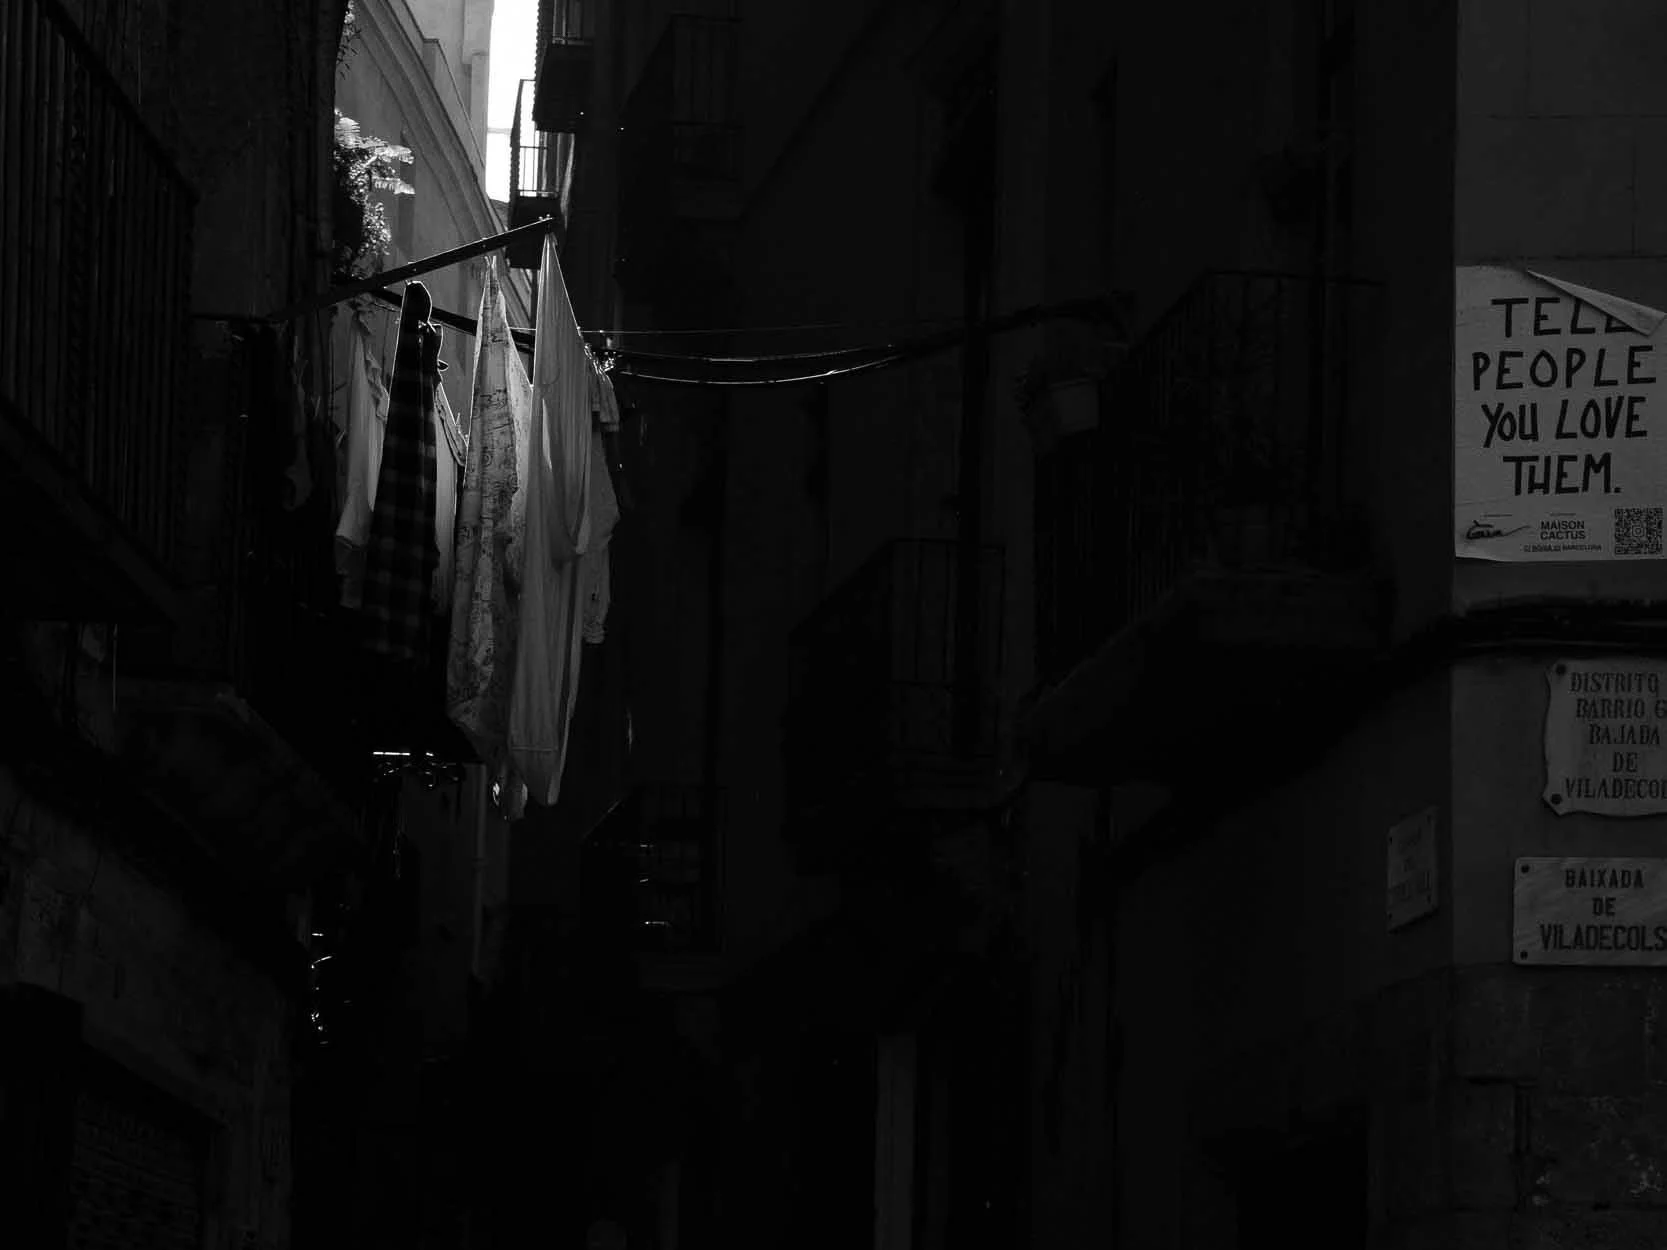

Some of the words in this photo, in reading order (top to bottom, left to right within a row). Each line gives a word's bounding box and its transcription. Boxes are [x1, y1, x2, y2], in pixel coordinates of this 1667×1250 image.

[1491, 297, 1635, 338] TELL
[1472, 345, 1657, 391] PEOPLE
[1555, 396, 1648, 439] LOVE
[1503, 452, 1622, 496] THEM.
[1540, 520, 1585, 531] MAISON
[1540, 531, 1586, 541] CACTUS
[1570, 672, 1660, 695] DISTRITO
[1576, 698, 1646, 719] BARRIO
[1589, 723, 1661, 745] BAJADA
[1612, 751, 1638, 772] DE
[1565, 868, 1644, 889] BAIXADA
[1592, 897, 1617, 916] DE
[1540, 924, 1667, 951] VILADECOLS
